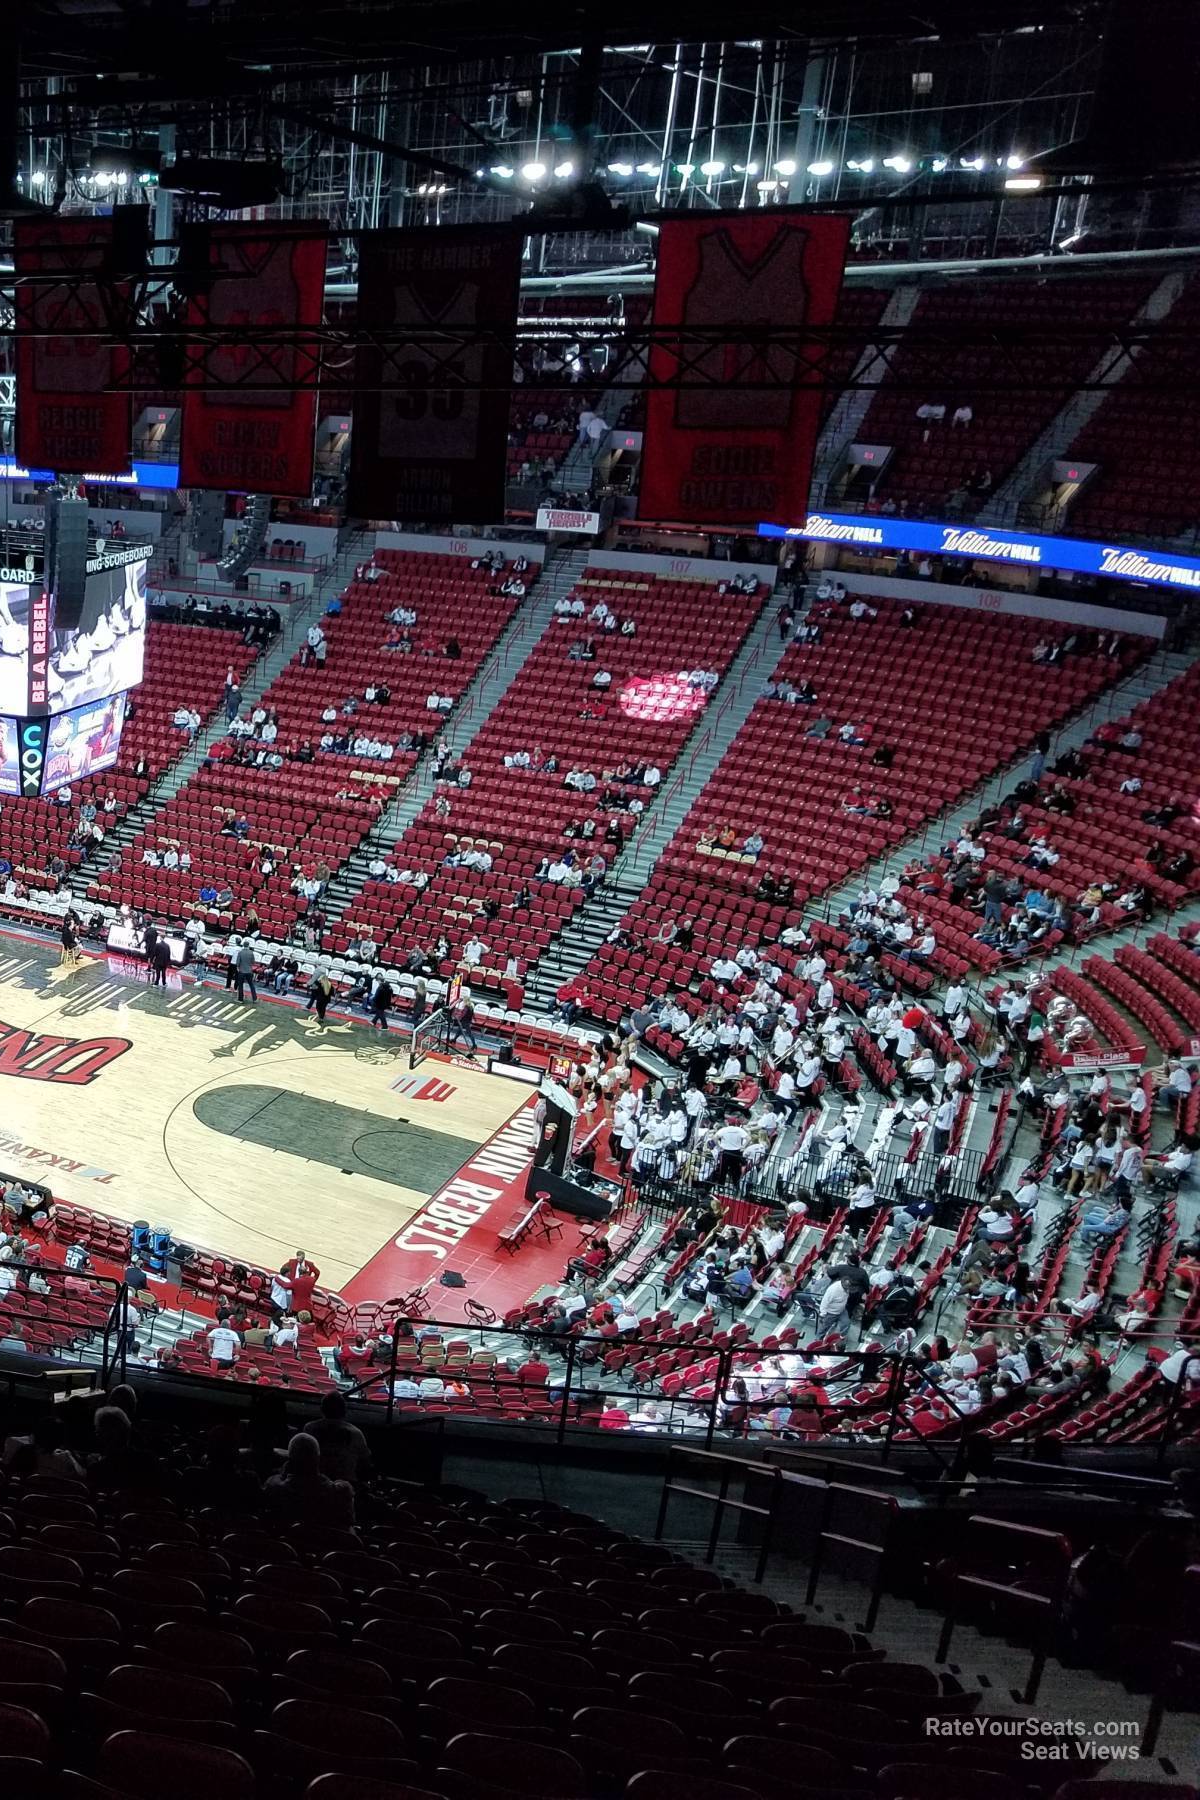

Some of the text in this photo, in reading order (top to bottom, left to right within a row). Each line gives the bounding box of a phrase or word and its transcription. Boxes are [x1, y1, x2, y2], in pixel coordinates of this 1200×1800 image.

[693, 446, 776, 477] EDDIE
[680, 480, 779, 512] OWENS
[104, 545, 154, 569] SCOREBOARD
[942, 527, 1041, 562] William HILL
[670, 560, 692, 573] 107
[1099, 548, 1171, 581] William
[977, 593, 1001, 608] 108
[32, 592, 49, 704] BE A REBEL.
[22, 725, 43, 788] COX
[1103, 1051, 1130, 1061] Place
[394, 1177, 504, 1260] REBELS
[64, 1255, 79, 1269] 58
